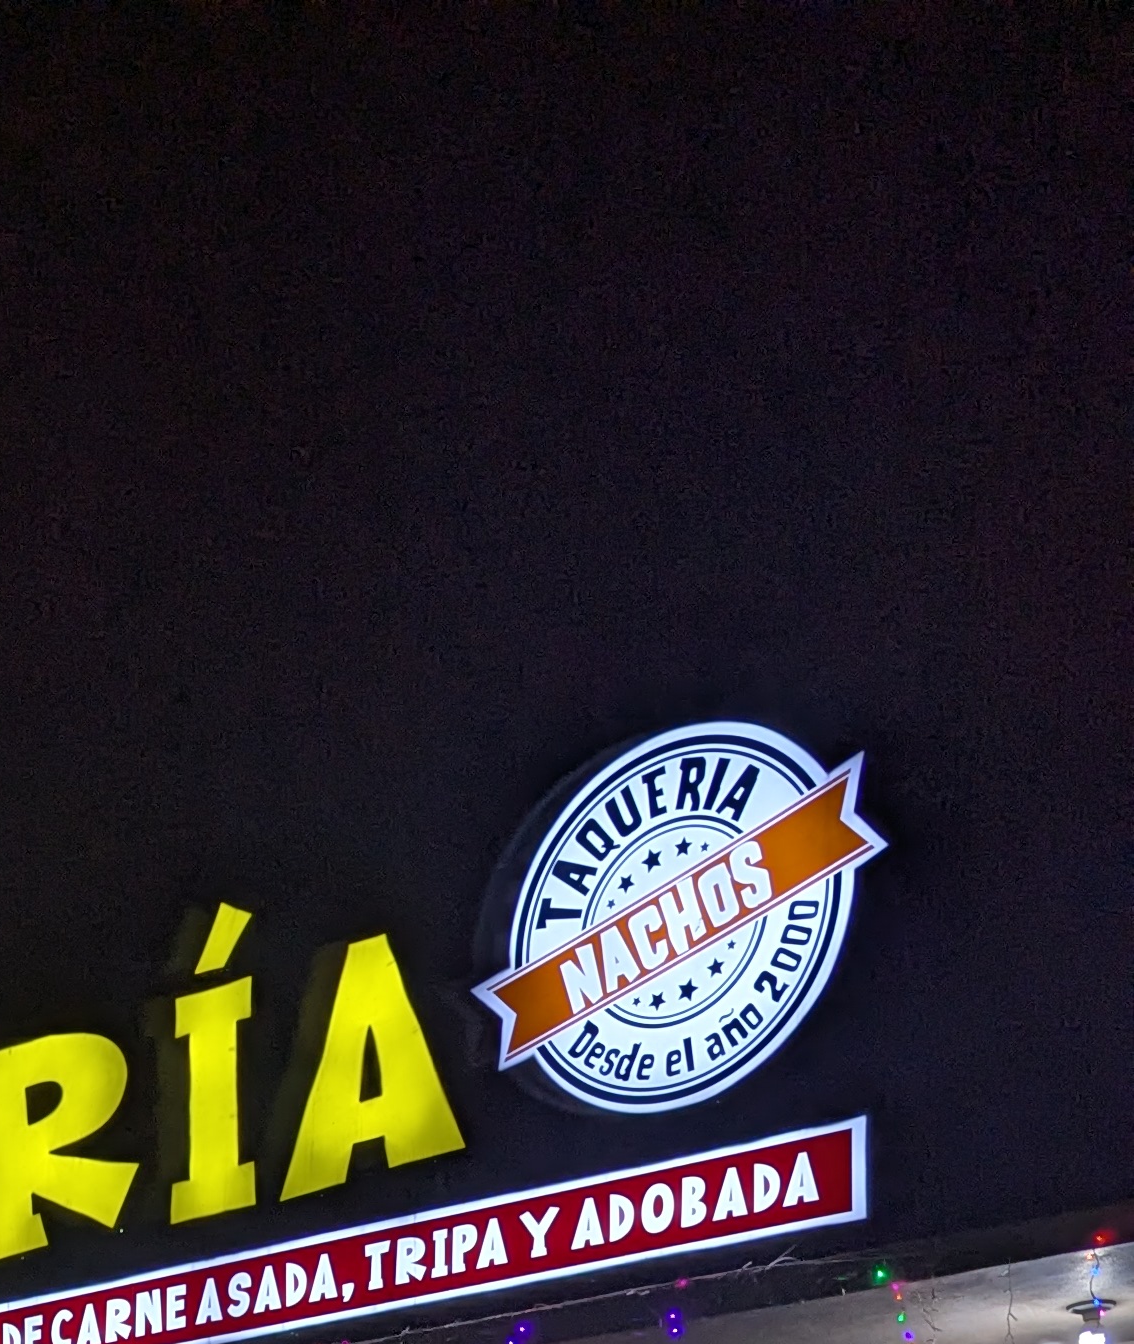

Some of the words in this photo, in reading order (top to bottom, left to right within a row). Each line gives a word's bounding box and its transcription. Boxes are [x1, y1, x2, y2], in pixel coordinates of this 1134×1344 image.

[535, 756, 760, 929] TAQUERIA
[559, 840, 773, 1016] NACHOS
[568, 1020, 655, 1081] Desde
[666, 1036, 695, 1077] el
[704, 1004, 764, 1061] año
[753, 900, 820, 1003] 2000
[194, 1253, 355, 1326] ASADA,
[364, 1217, 509, 1291] TRIPA
[519, 1206, 560, 1259] Y
[570, 1151, 820, 1251] ADOBADA
